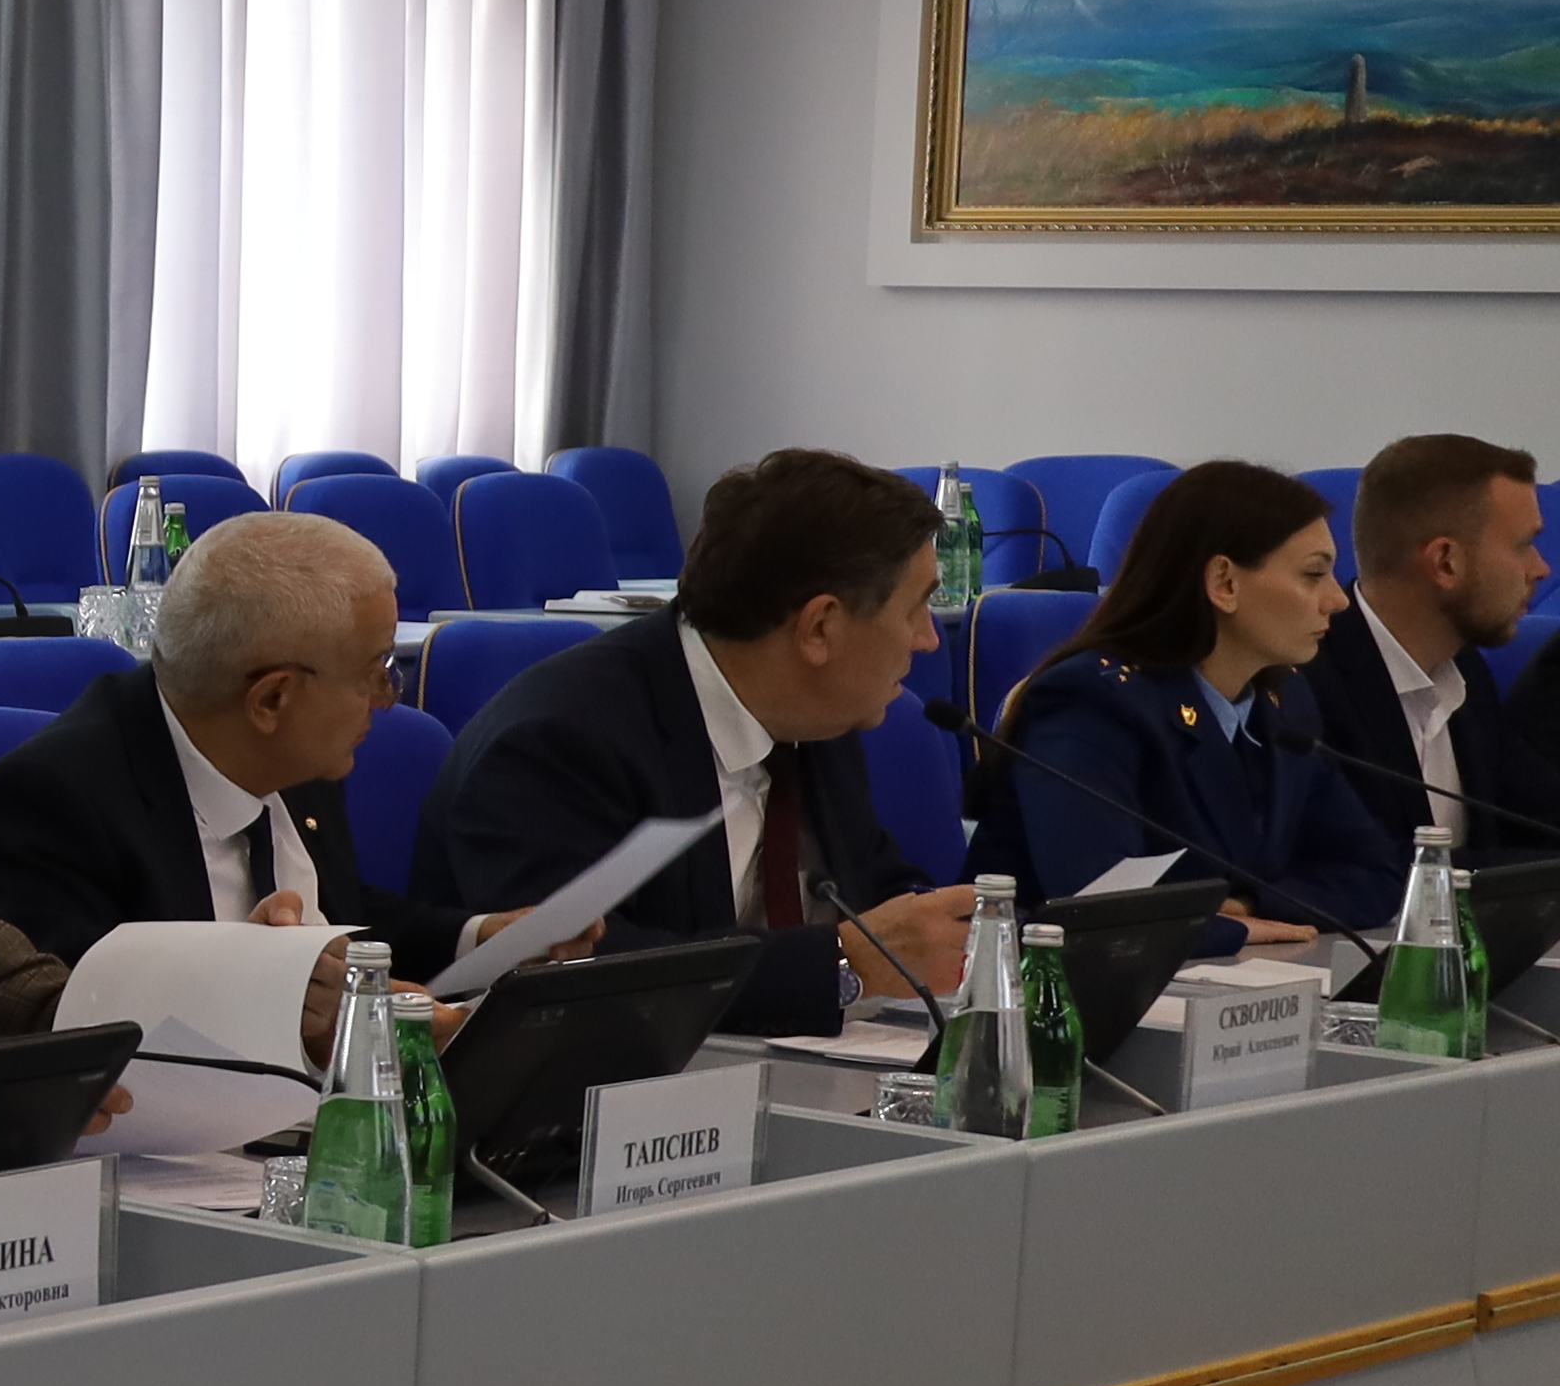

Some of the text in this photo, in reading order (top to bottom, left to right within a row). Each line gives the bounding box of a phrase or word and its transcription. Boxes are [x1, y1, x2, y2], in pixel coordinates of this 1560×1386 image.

[1219, 994, 1300, 1030] СКВОРЦОВ
[623, 1127, 721, 1169] ТАПСИЕВ
[616, 1170, 722, 1206] Игорь Сергеевич
